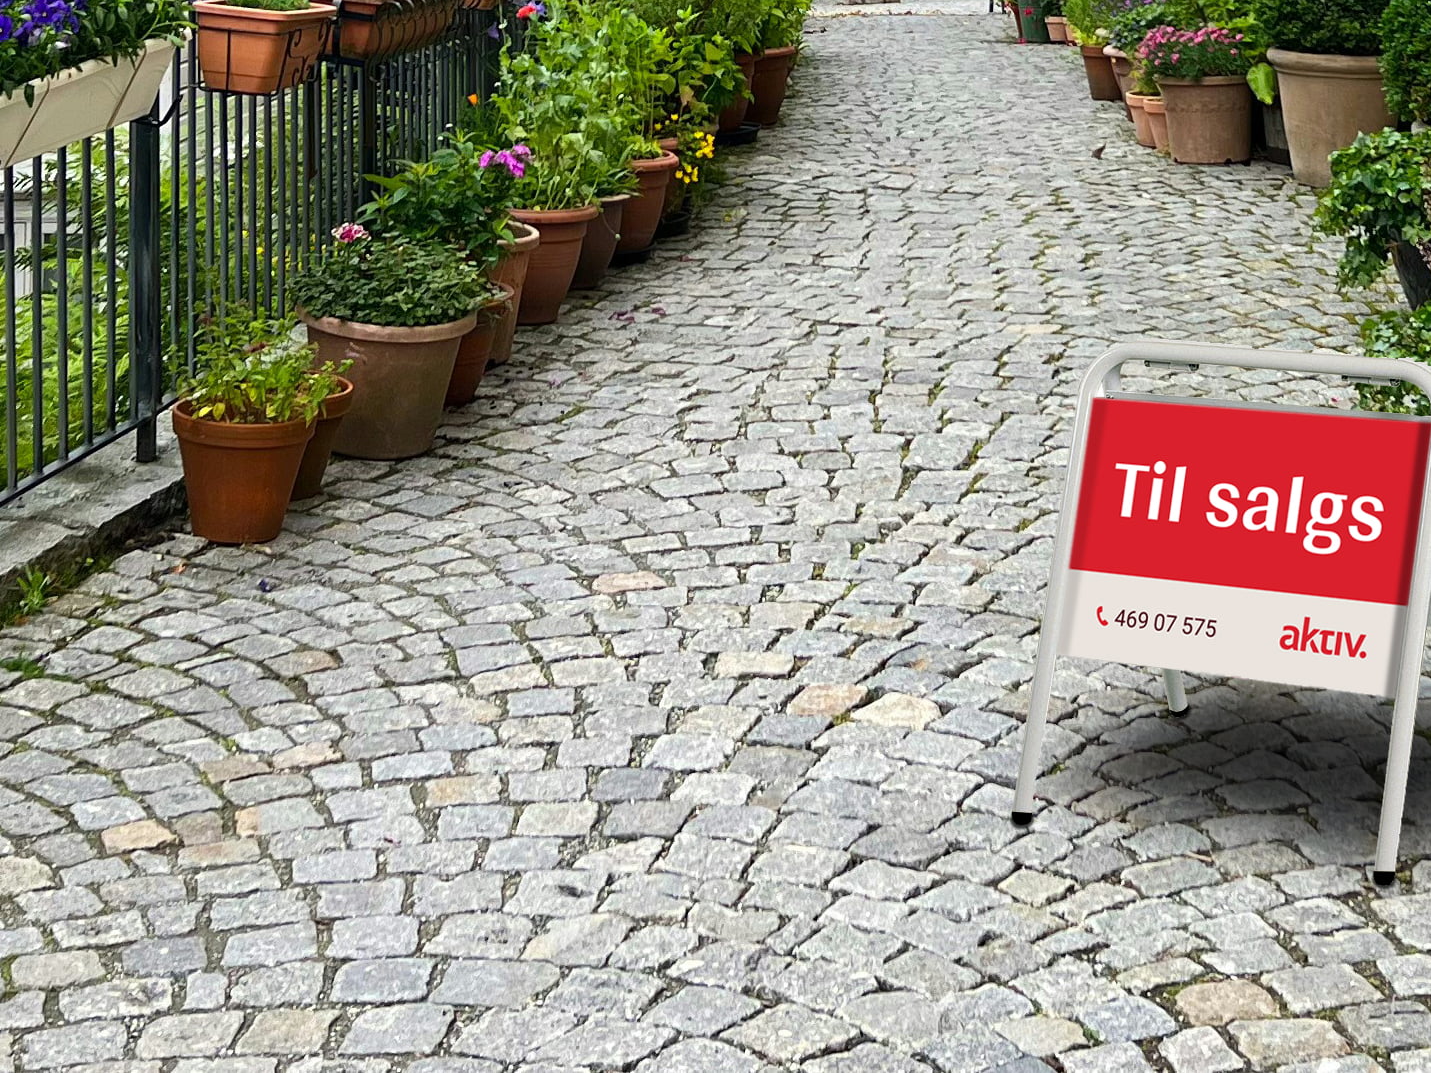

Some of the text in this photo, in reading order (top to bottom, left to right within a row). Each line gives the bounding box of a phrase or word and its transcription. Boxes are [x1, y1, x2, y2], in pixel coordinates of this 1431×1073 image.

[1114, 460, 1385, 555] Til salgs
[1113, 608, 1218, 638] 469 07 575
